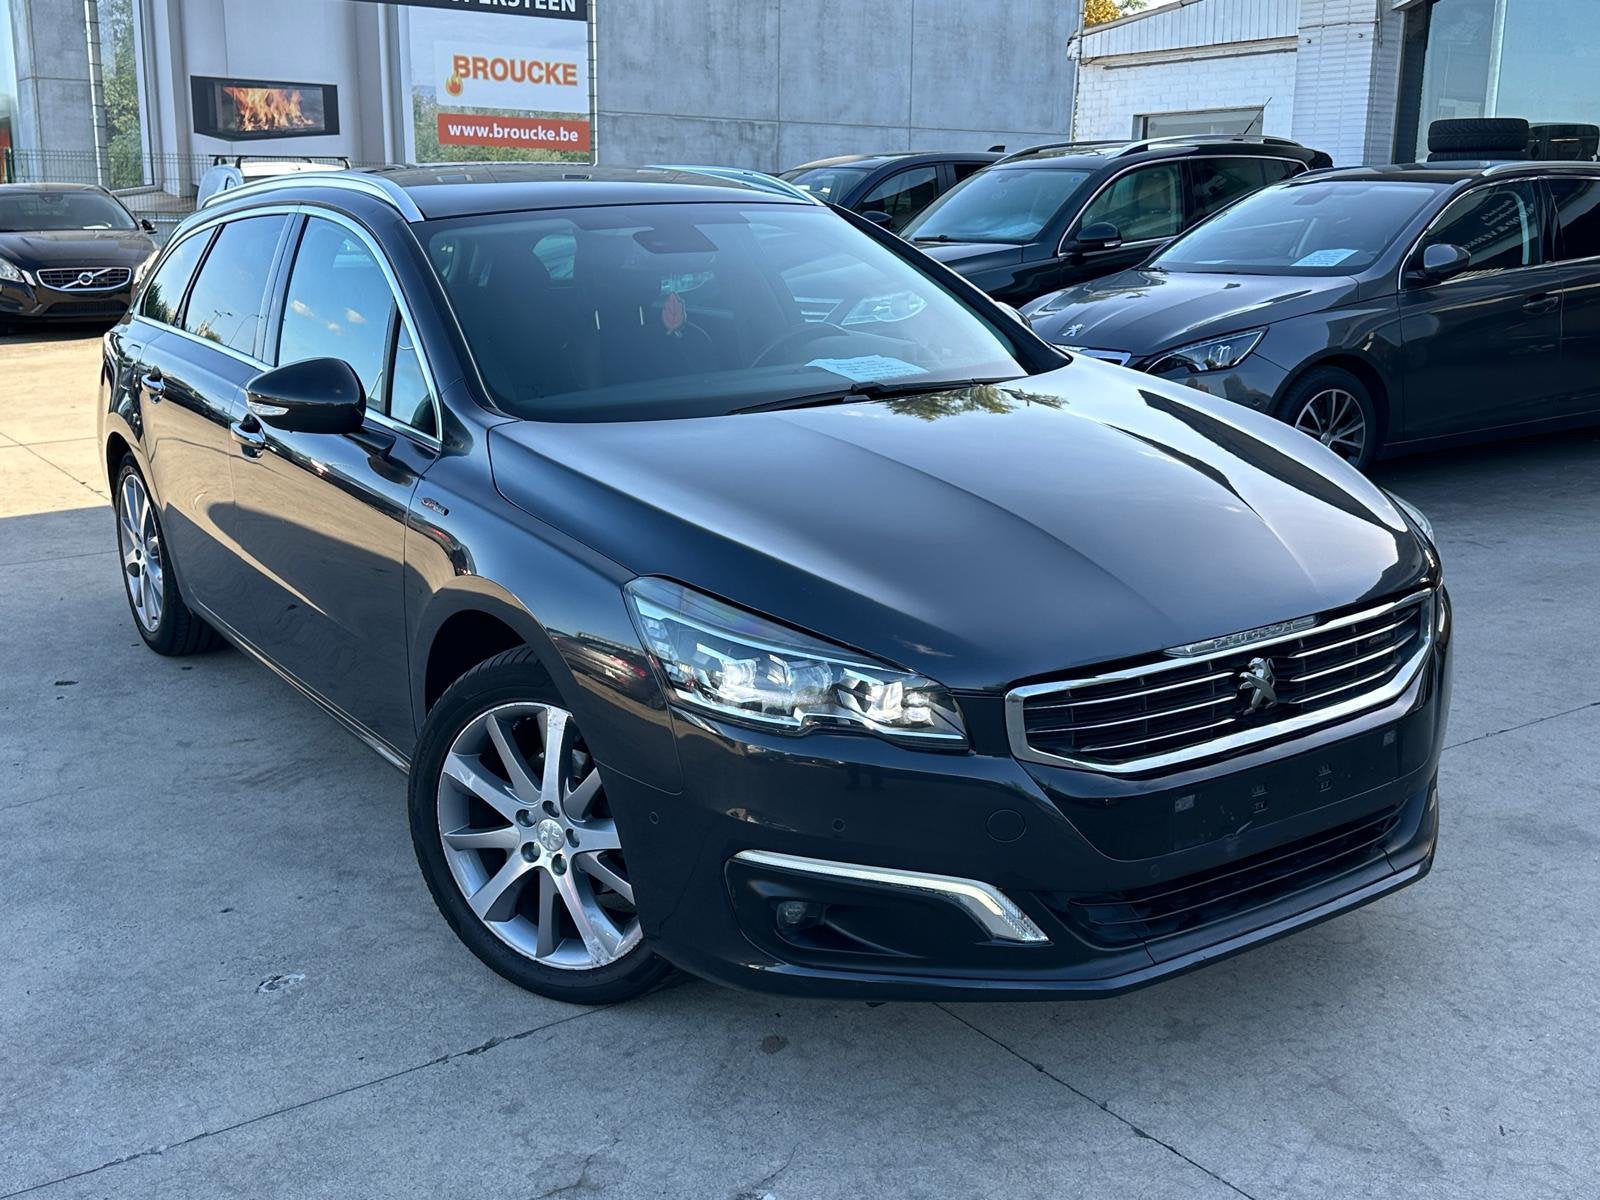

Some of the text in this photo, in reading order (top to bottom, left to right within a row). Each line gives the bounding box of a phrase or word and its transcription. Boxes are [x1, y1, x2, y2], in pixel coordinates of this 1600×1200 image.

[453, 54, 578, 86] BROUCKE
[447, 122, 579, 142] www.broucke.be
[1213, 621, 1294, 649] PEUGEOT
